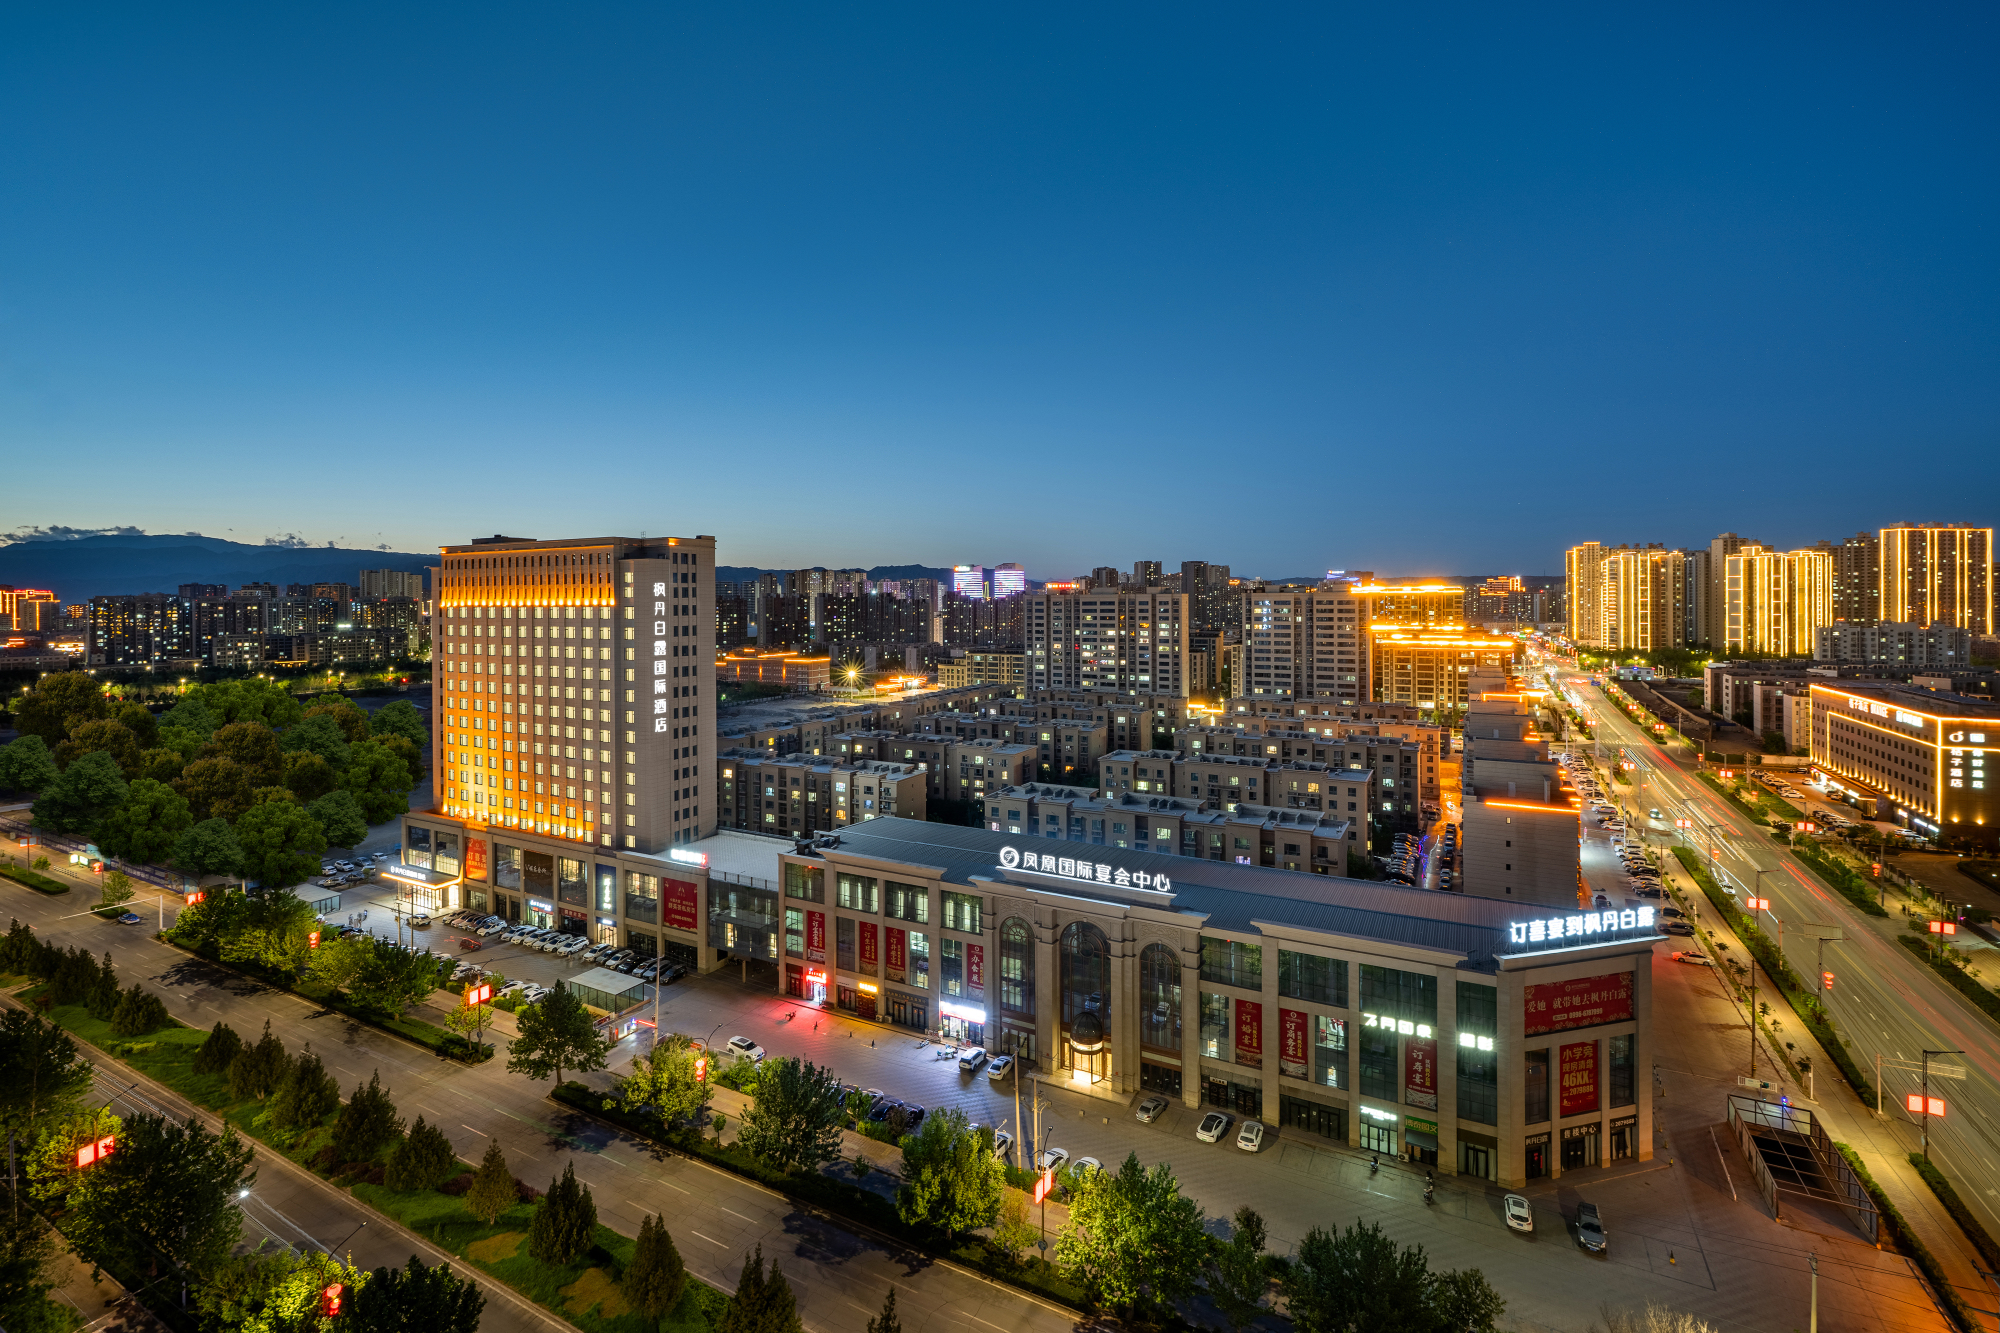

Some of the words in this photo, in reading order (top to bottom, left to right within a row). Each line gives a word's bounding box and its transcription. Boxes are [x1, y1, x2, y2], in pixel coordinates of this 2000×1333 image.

[653, 582, 667, 733] 枫丹白露国际酒店
[1023, 851, 1171, 892] 凤凰国际宴会中心
[1510, 906, 1655, 943] 订喜宴到枫丹白露
[1527, 999, 1547, 1014] 爱她
[1552, 987, 1627, 1010] 就带她去枫丹白露
[1286, 1021, 1297, 1056] 订商务宴
[1562, 1045, 1594, 1062] 小学旁
[1412, 1049, 1424, 1085] 订寿宴
[1562, 1070, 1590, 1088] 46XX
[1564, 1124, 1597, 1139] 售楼中心
